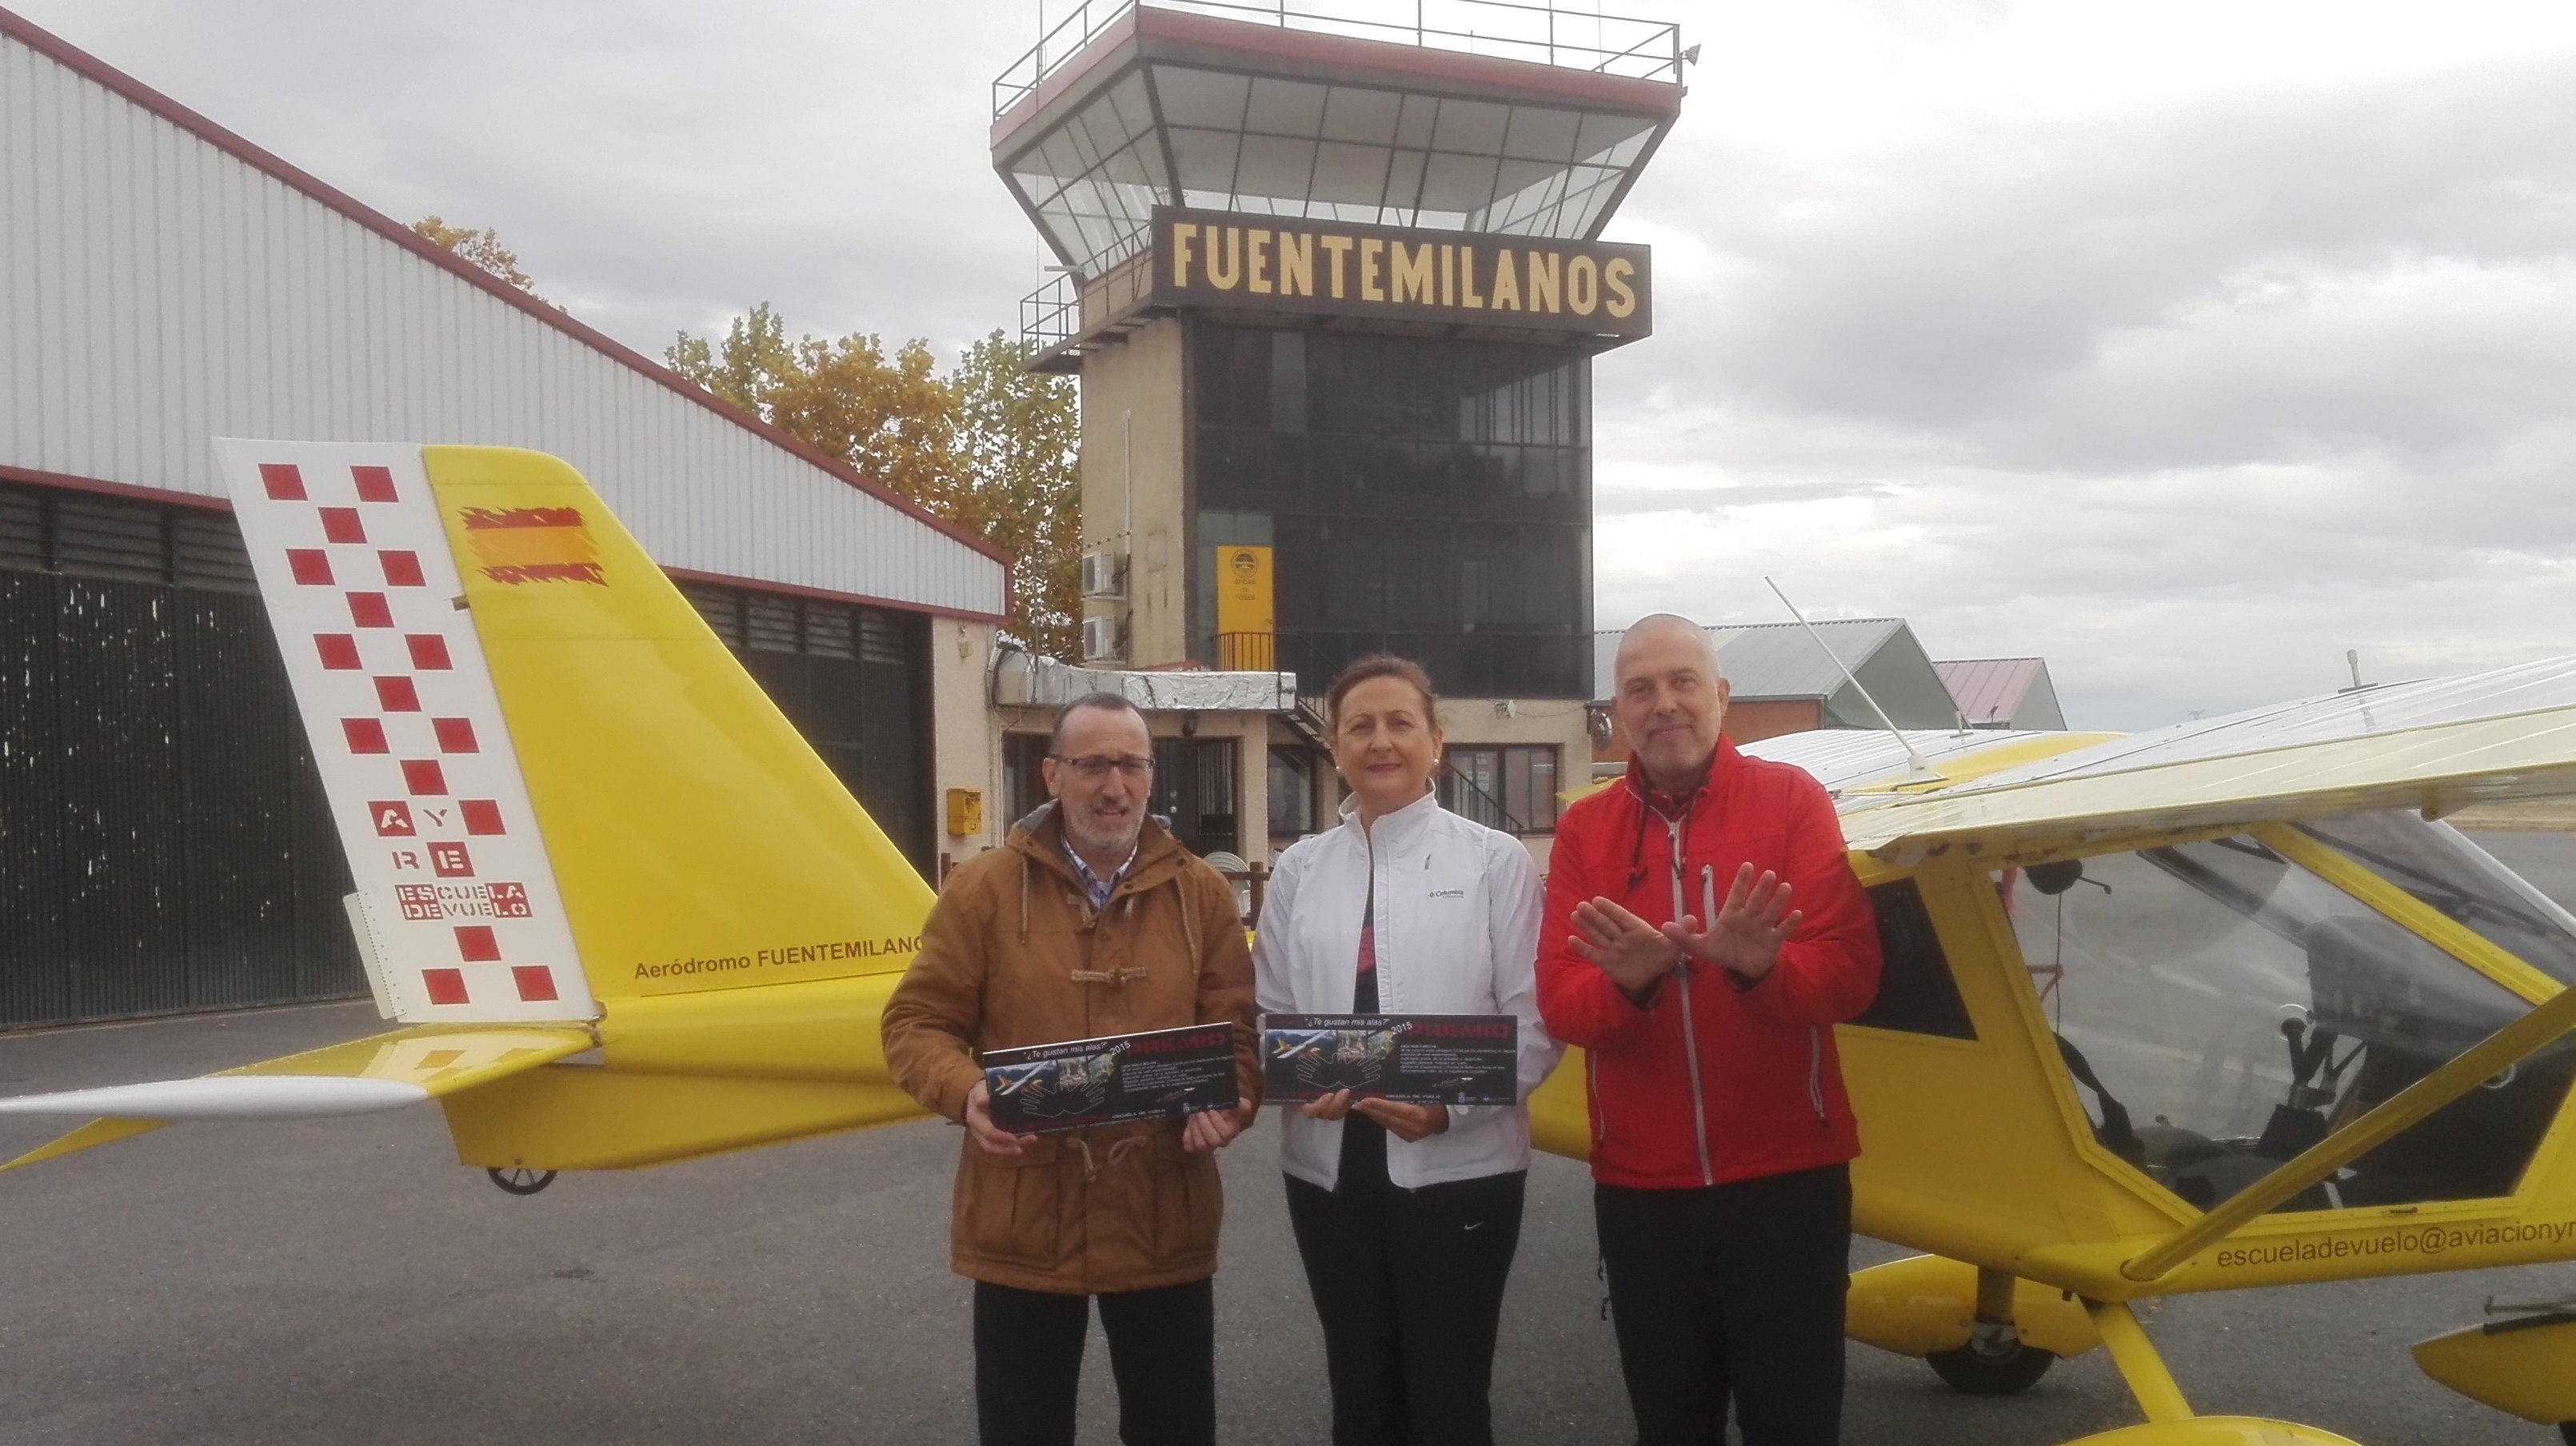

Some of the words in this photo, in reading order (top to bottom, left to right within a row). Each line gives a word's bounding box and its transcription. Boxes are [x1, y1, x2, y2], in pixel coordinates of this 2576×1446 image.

[1172, 222, 1635, 318] FUENTEMILANOS
[398, 885, 525, 902] ESCUELA
[634, 956, 751, 980] Aeródromo
[1390, 1021, 1413, 1036] 2015
[1042, 1047, 1068, 1057] gustan
[1109, 1040, 1132, 1056] 2015
